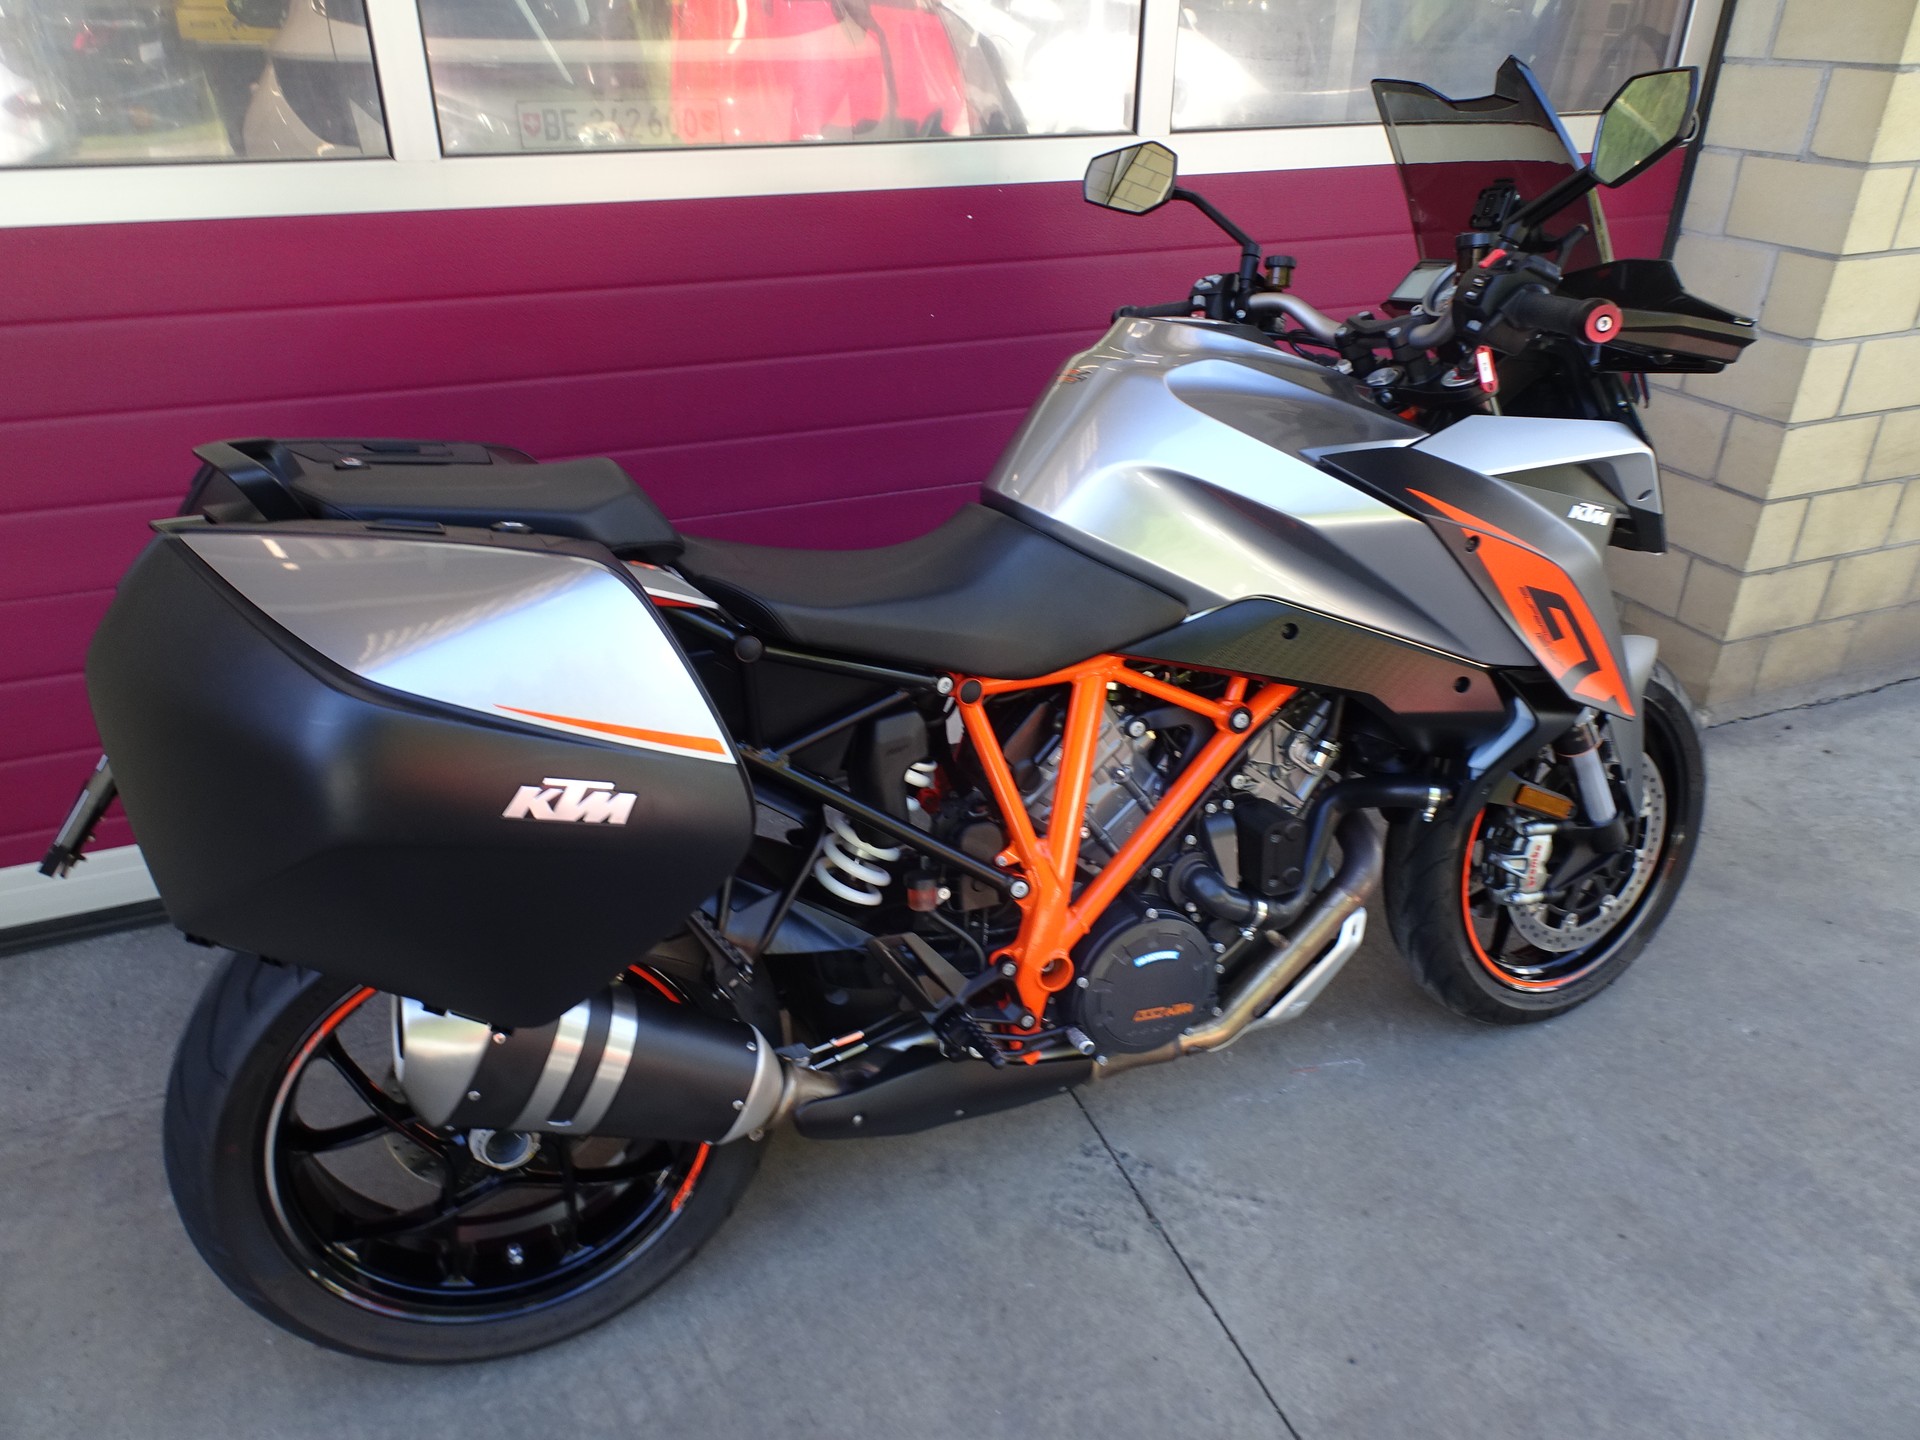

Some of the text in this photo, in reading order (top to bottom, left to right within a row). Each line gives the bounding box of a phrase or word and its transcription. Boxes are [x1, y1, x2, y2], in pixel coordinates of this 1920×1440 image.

[542, 108, 577, 141] BE
[1567, 502, 1612, 526] KTM
[501, 777, 638, 825] KTM
